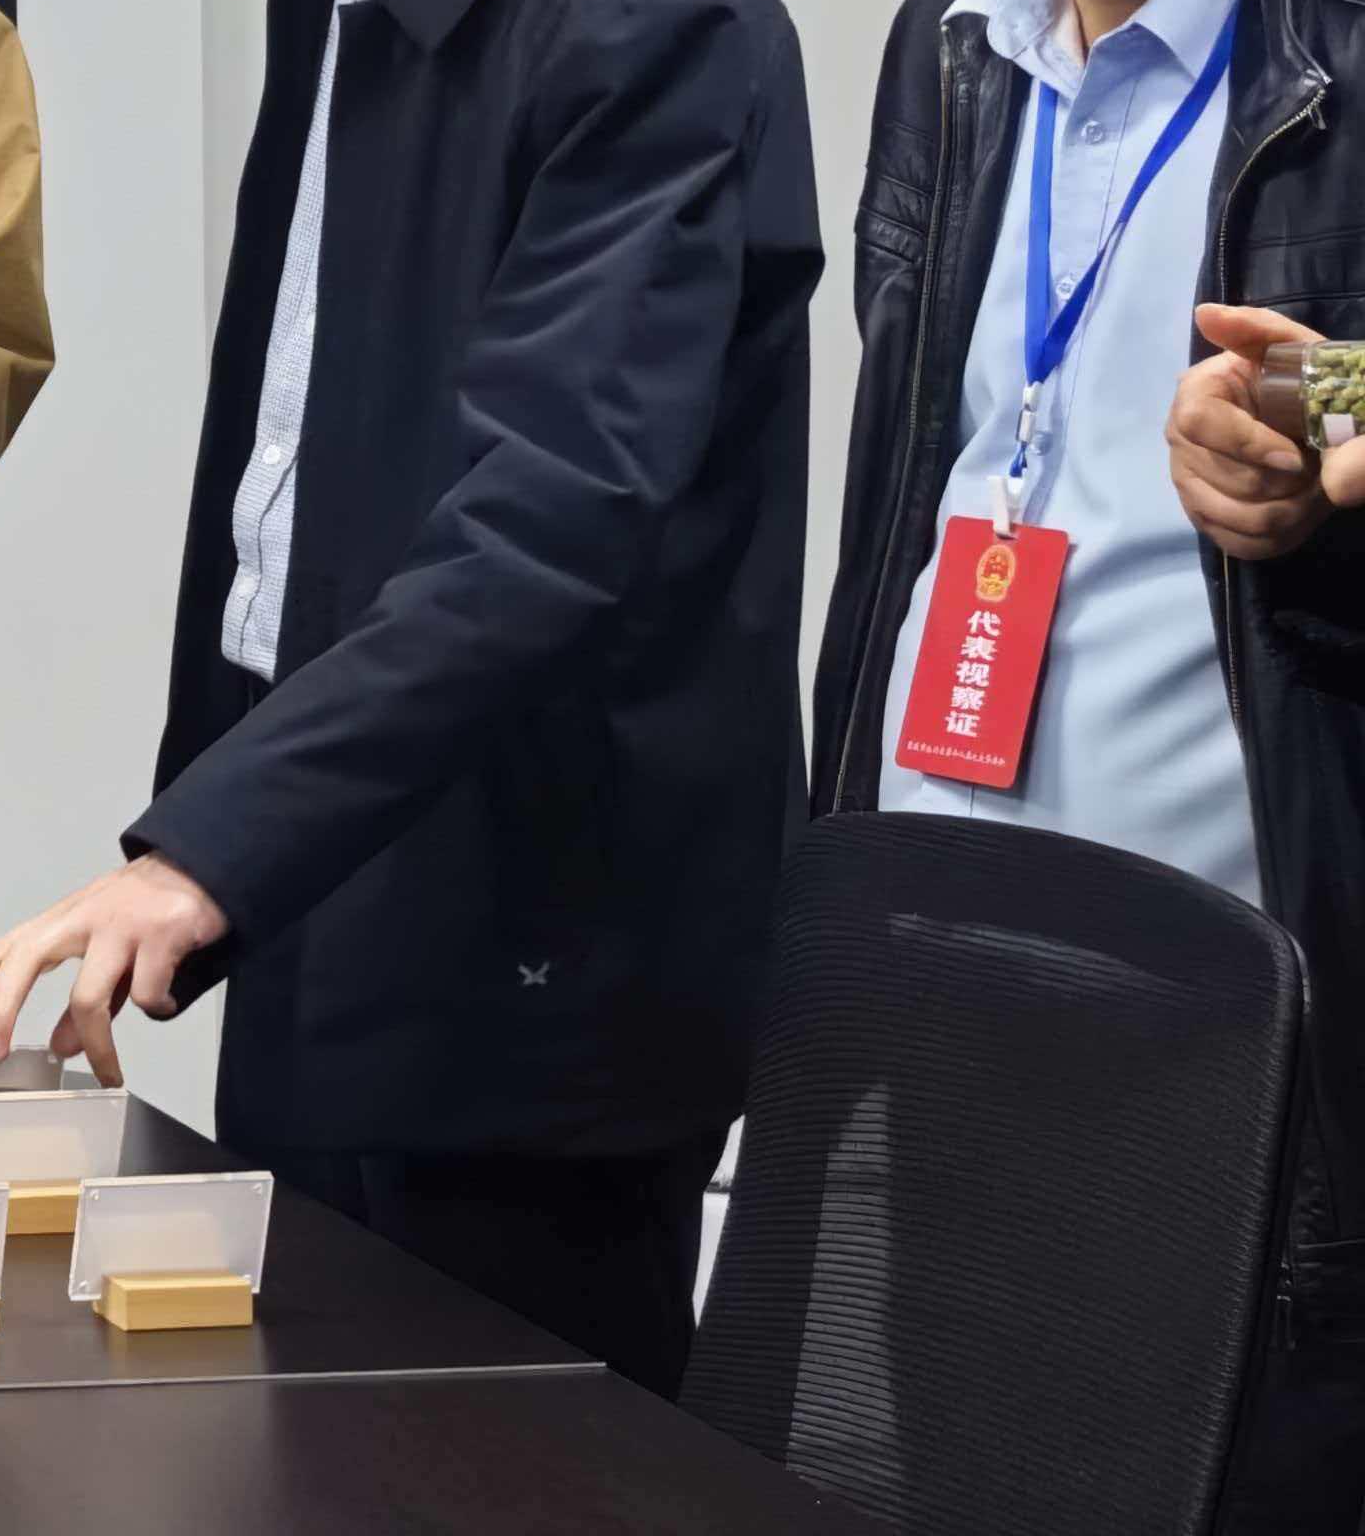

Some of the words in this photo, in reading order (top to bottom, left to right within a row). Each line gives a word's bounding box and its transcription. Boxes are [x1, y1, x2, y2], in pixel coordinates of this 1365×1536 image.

[944, 610, 1002, 737] 代表视察证
